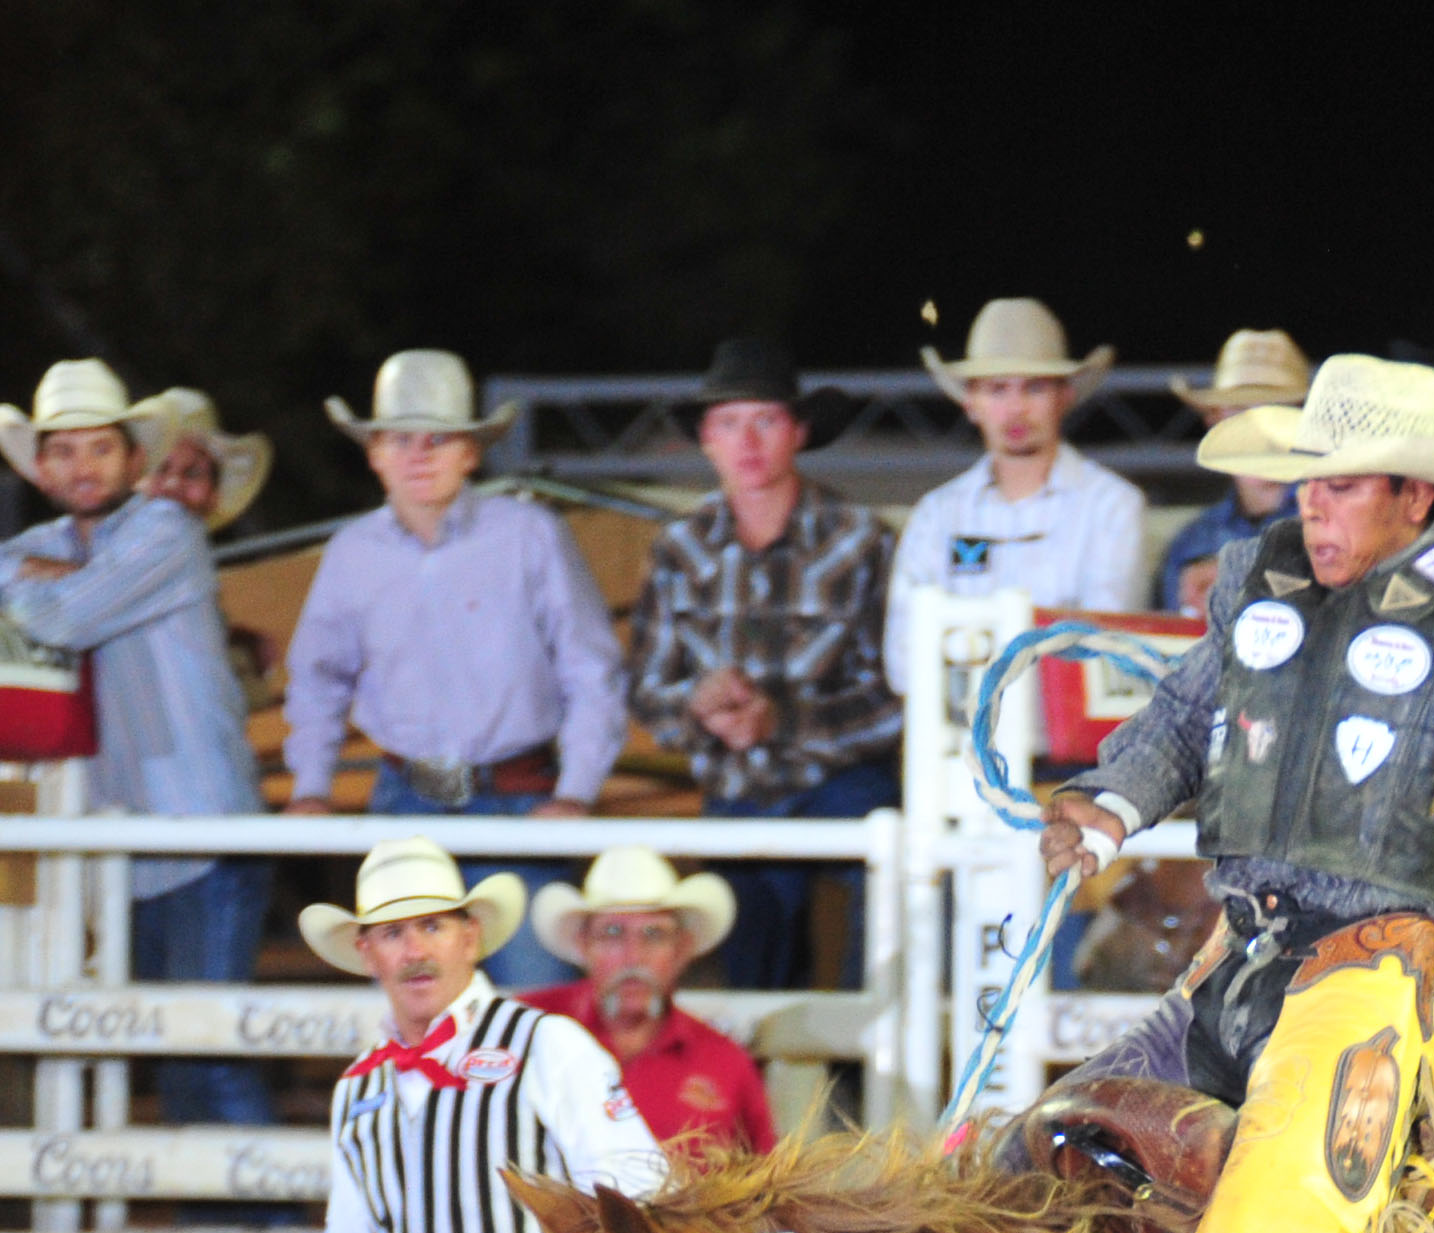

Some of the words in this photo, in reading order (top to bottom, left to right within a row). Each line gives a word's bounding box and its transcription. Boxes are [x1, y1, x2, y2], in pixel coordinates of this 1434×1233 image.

[37, 988, 165, 1041] Coors
[238, 999, 360, 1047] Coors
[32, 1134, 156, 1192] Coors
[226, 1147, 330, 1200] Coor
